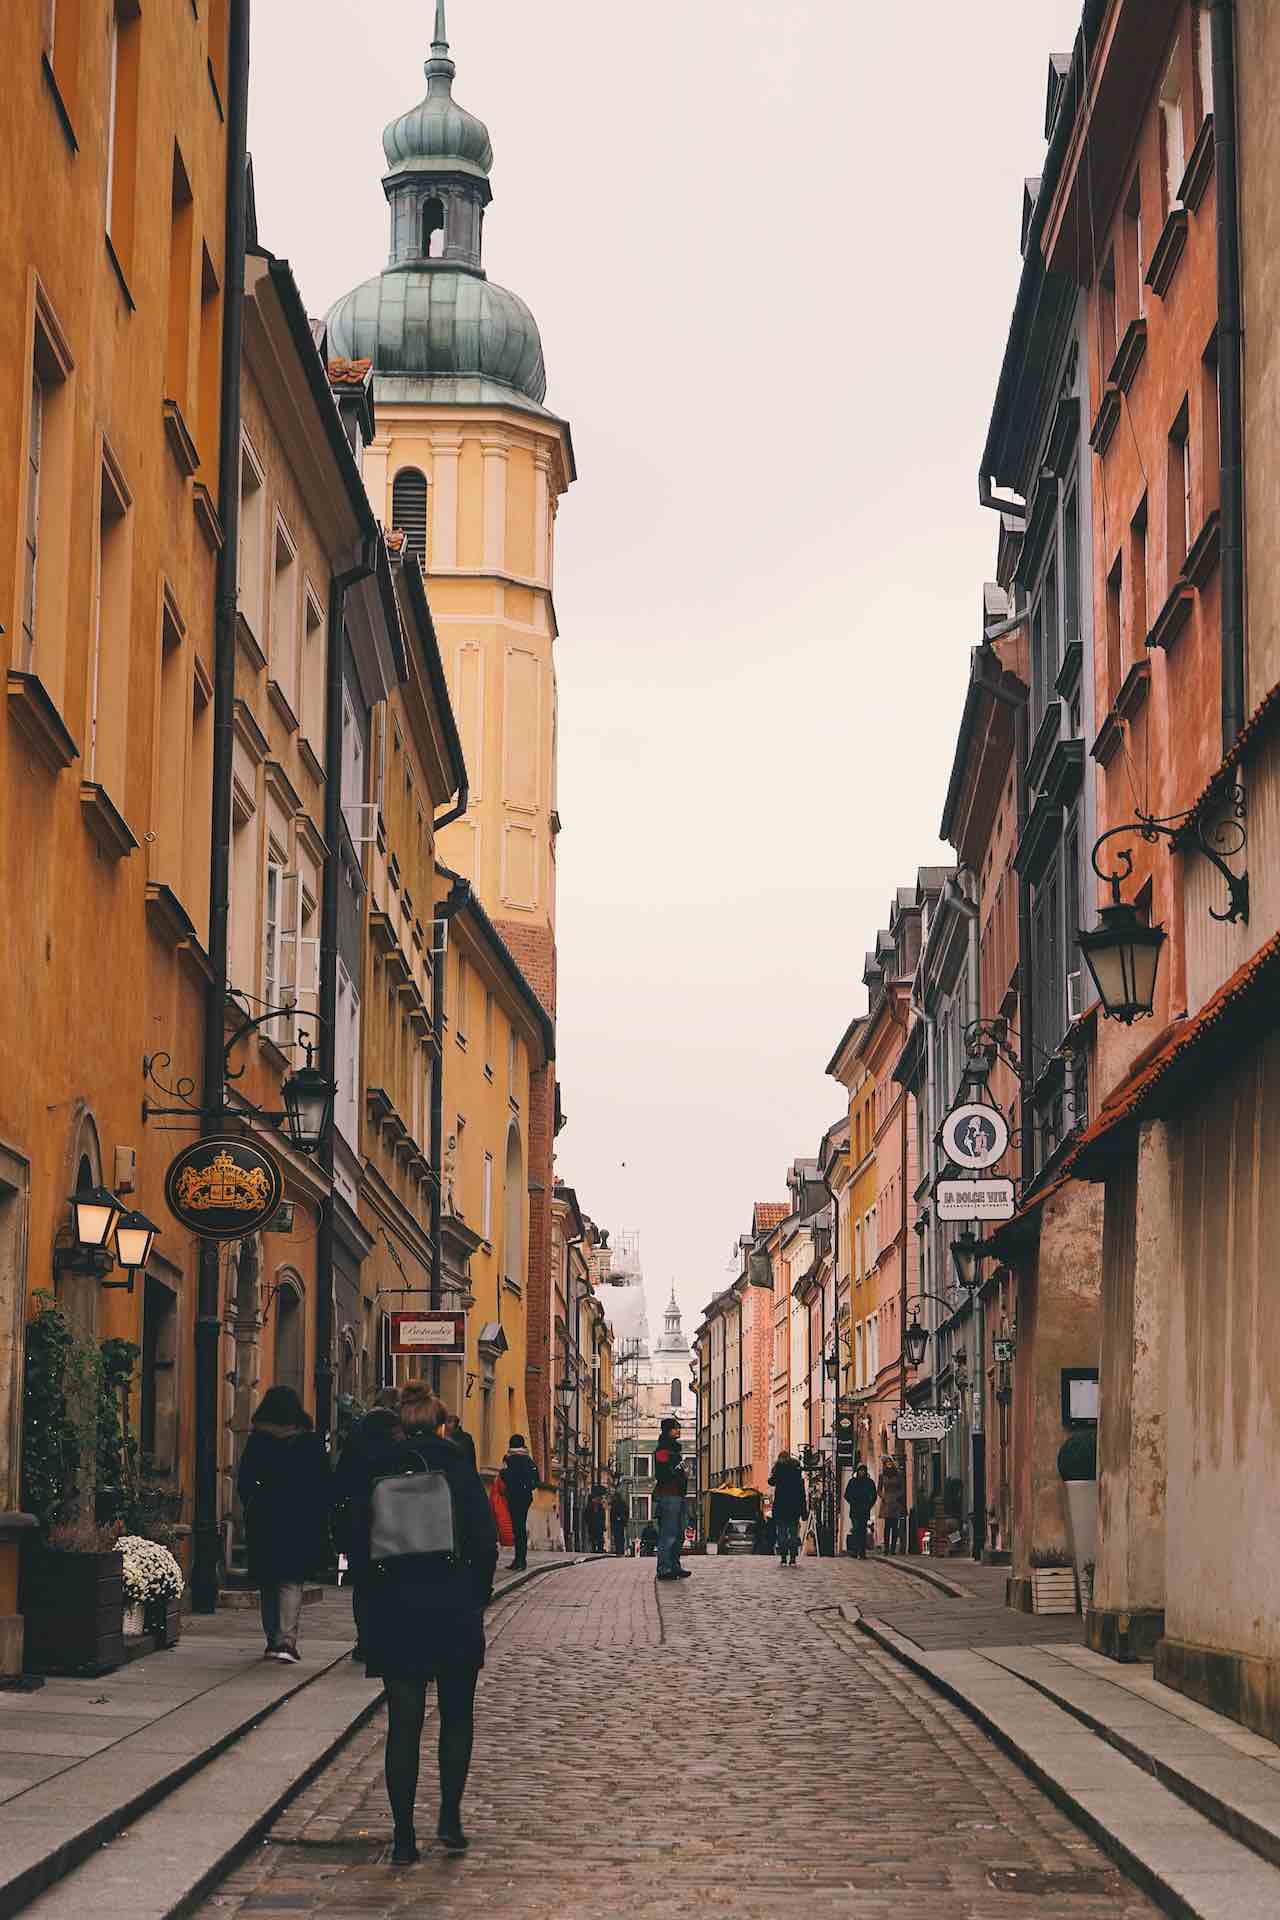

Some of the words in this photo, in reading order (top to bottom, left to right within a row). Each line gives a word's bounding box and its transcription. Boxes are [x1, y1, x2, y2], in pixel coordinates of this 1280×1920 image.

[944, 1192, 954, 1204] LA
[956, 1191, 985, 1204] DOLCE
[986, 1191, 1007, 1203] VITA
